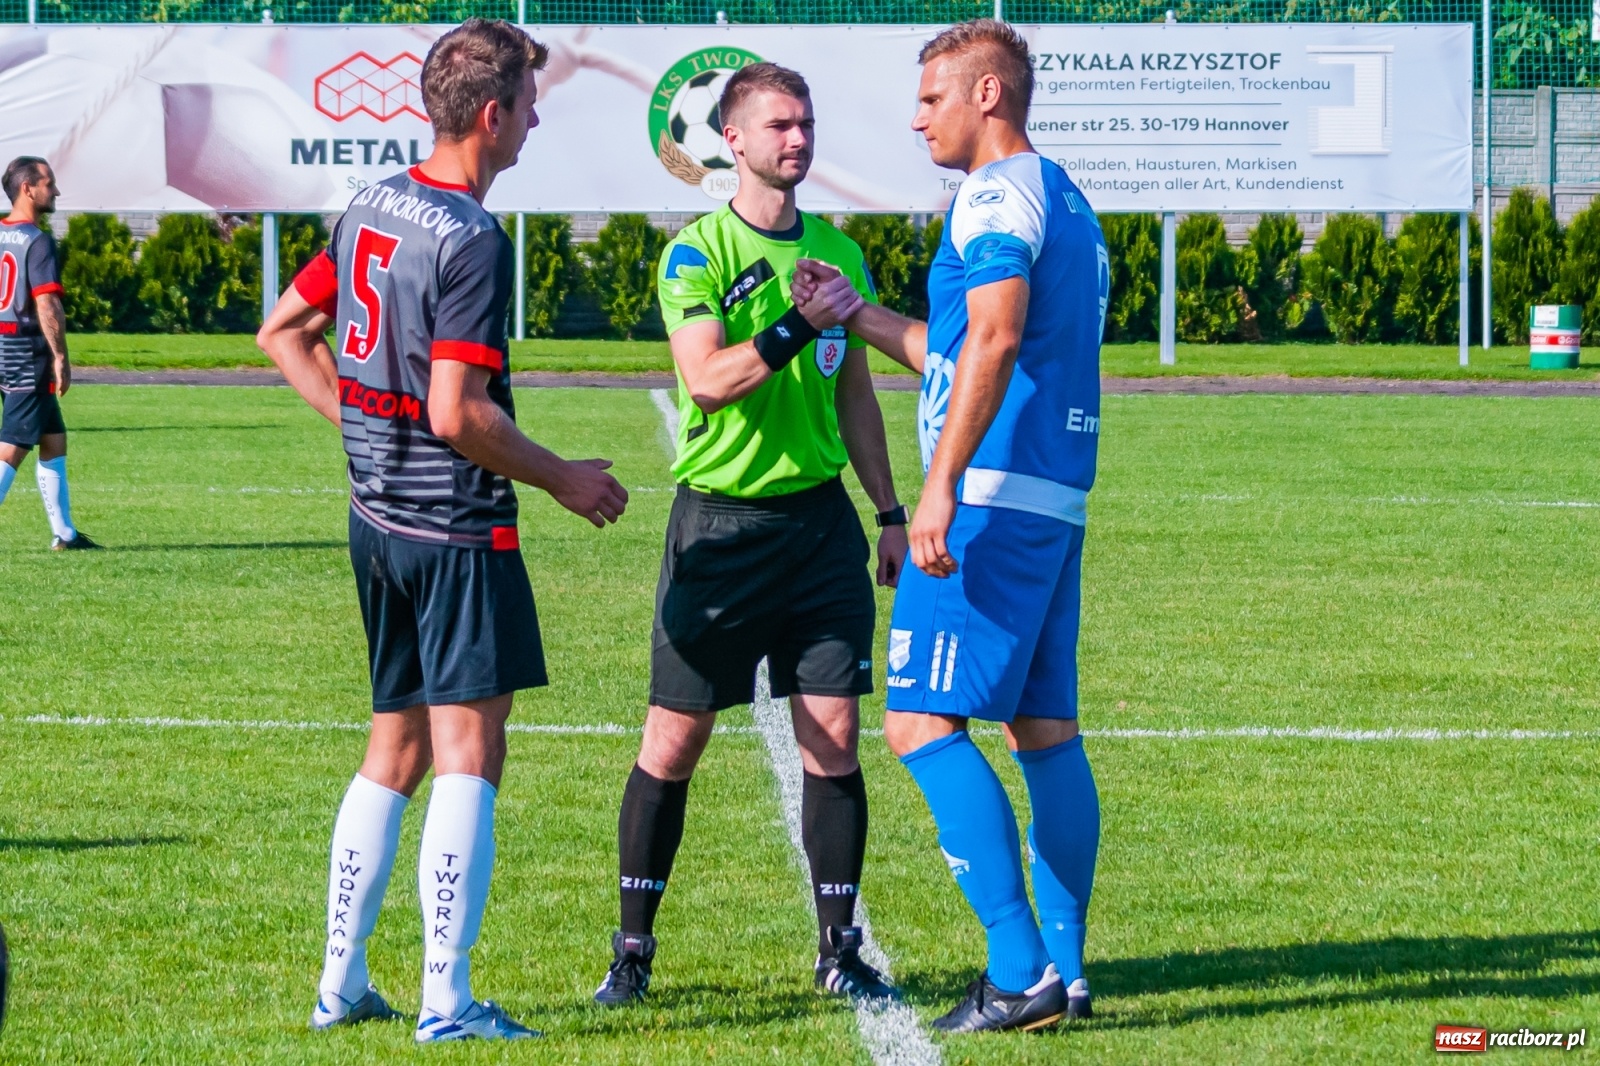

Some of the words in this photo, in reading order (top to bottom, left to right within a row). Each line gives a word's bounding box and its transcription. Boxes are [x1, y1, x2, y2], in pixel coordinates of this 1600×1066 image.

[1141, 53, 1282, 71] KRZYSZTOF
[653, 71, 683, 113] LKS
[1048, 78, 1135, 97] genormten
[1140, 78, 1235, 95] Fertigteilen,
[1239, 77, 1331, 91] Trockenbau
[1027, 120, 1077, 132] uener
[1081, 118, 1105, 132] str
[1108, 118, 1135, 132] 25.
[1140, 117, 1200, 132] 30-179
[1204, 117, 1290, 132] Hannover
[291, 138, 435, 165] METAL
[1059, 158, 1131, 173] Rolladen,
[1136, 157, 1221, 173] Hausturen,
[1226, 157, 1297, 171] Markisen
[708, 177, 738, 192] 1905
[1078, 178, 1161, 194] Montagen
[1165, 177, 1199, 190] aller
[1203, 177, 1230, 192] Art,
[1236, 176, 1344, 190] Kundendienst
[371, 185, 464, 238] TWORKÓW
[342, 223, 402, 364] 5
[428, 852, 461, 974] TWORKW
